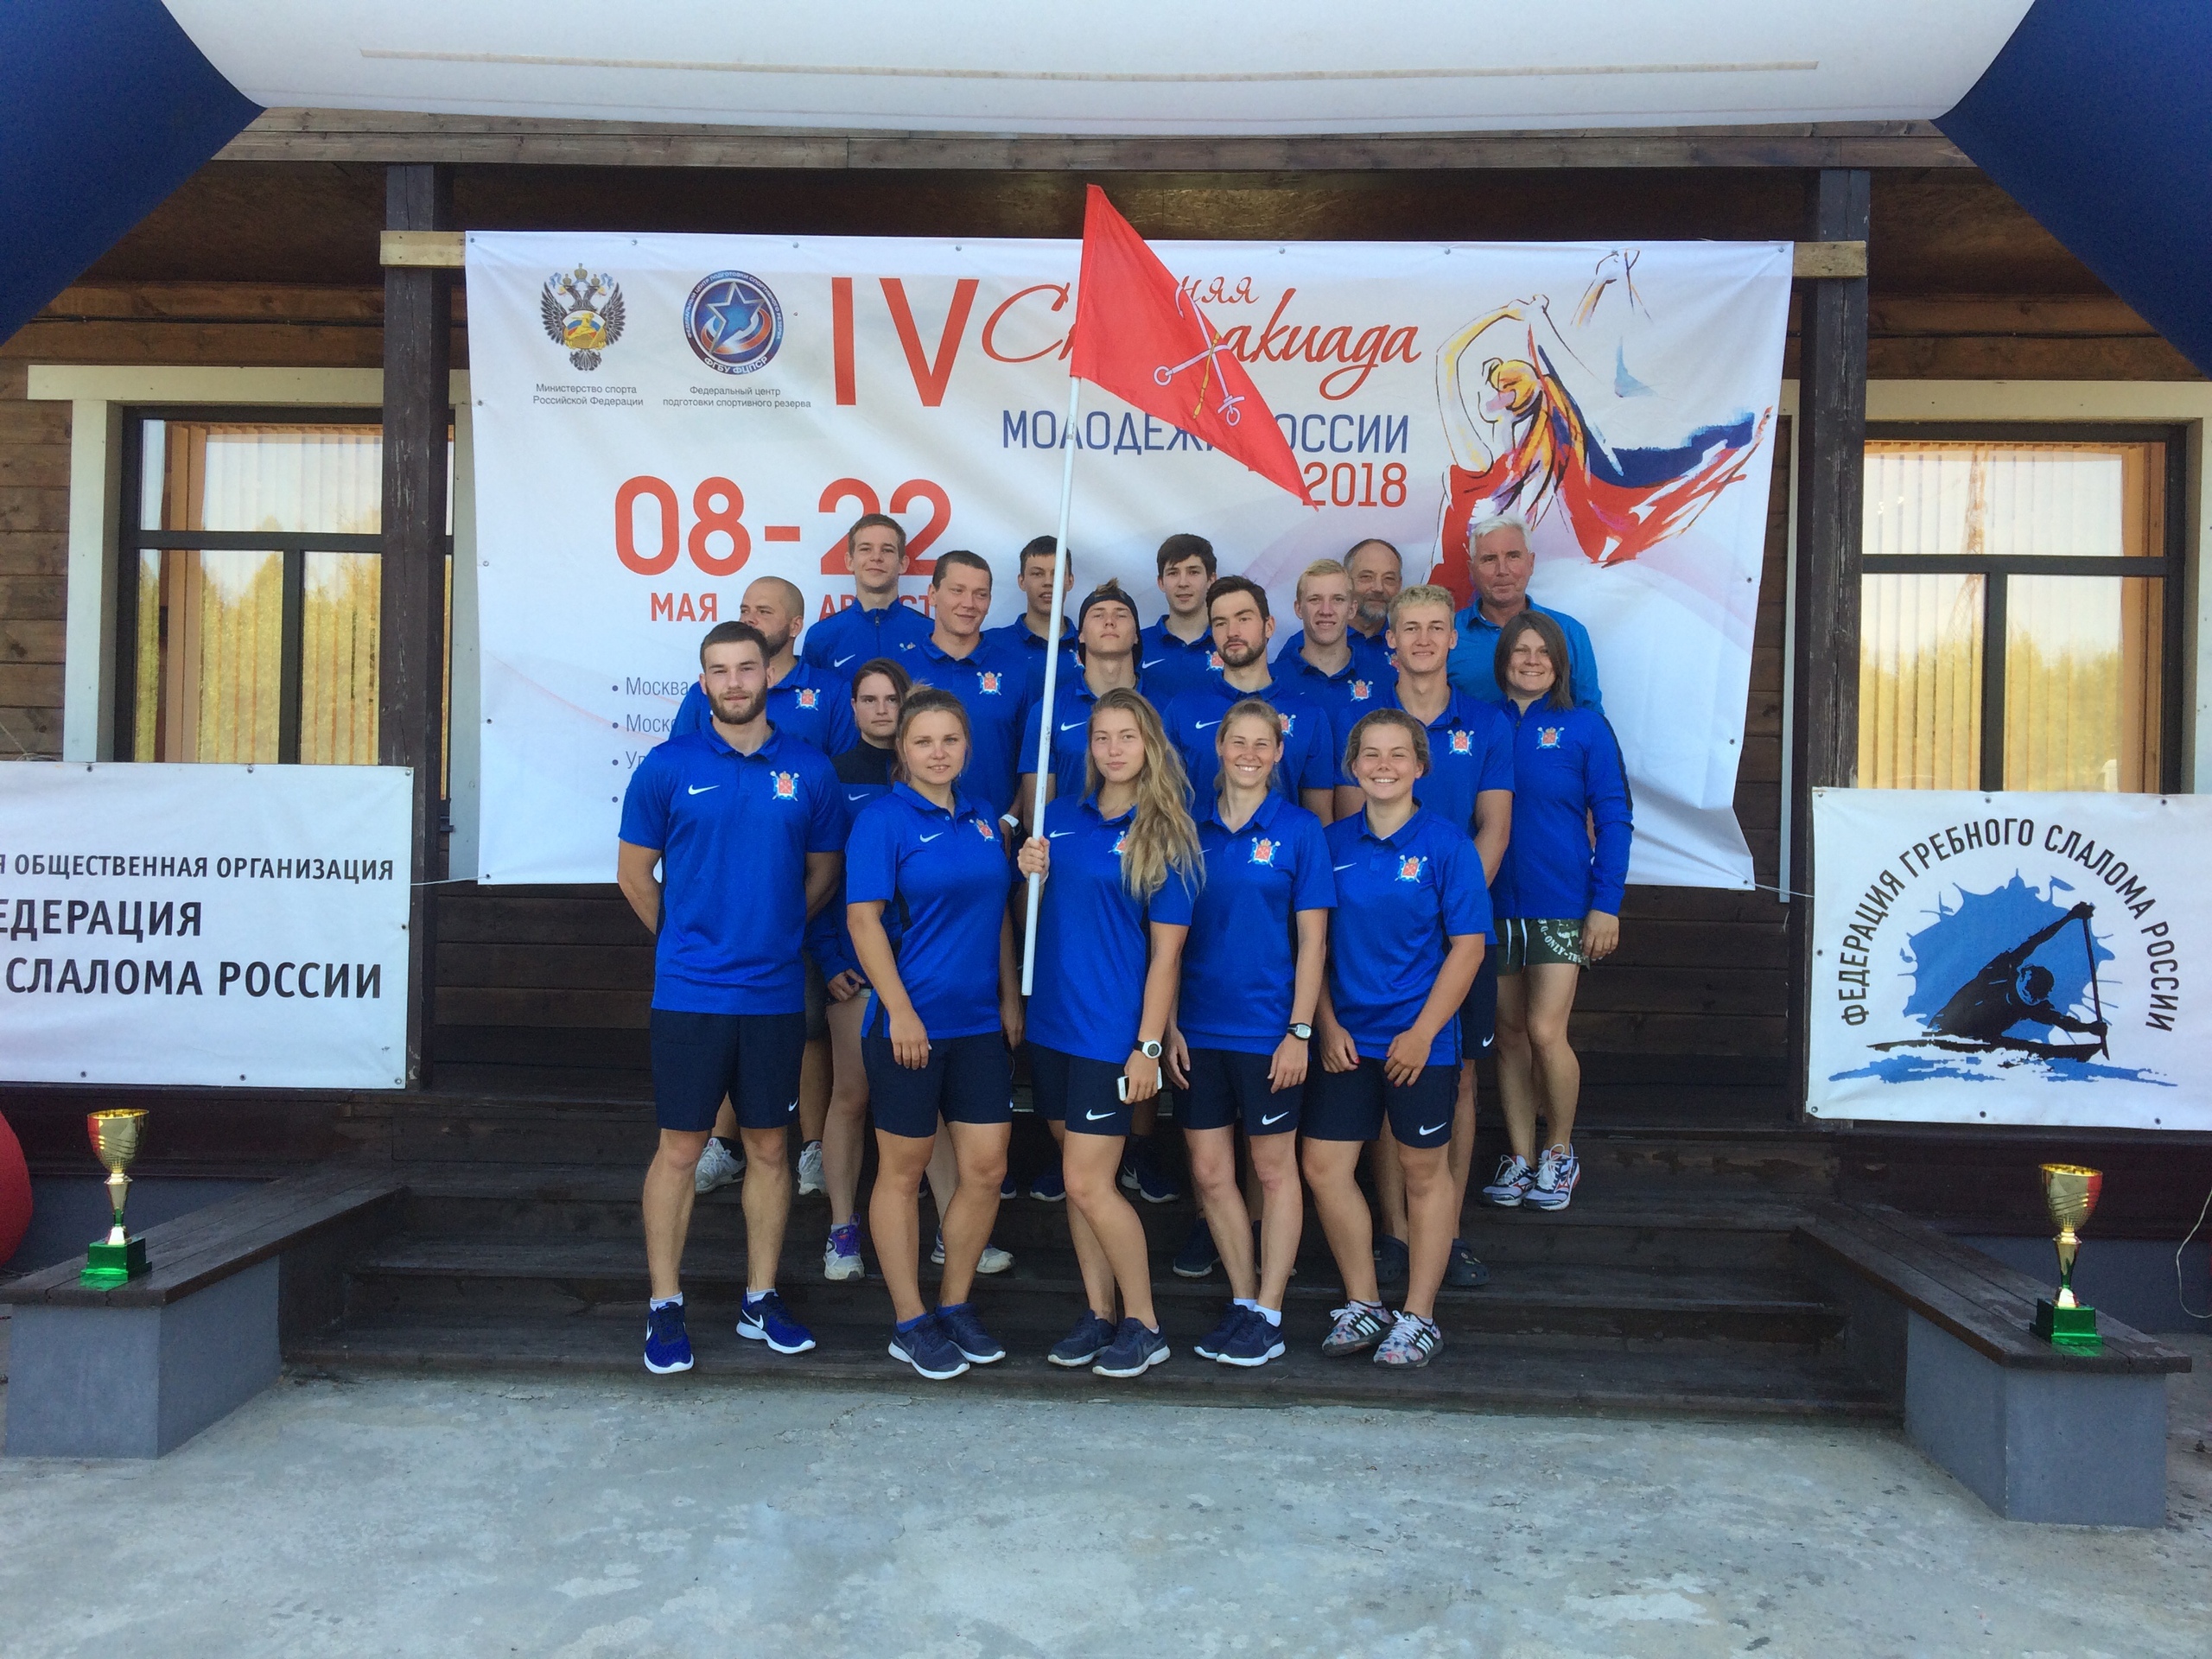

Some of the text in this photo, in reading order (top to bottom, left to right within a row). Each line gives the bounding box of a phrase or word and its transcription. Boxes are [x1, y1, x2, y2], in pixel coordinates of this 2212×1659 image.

[695, 278, 709, 296] ЦЕНТР
[831, 276, 980, 407] IV
[982, 282, 1422, 401] Сакиада
[704, 356, 768, 374] ФГБУ ФЦПСР
[533, 396, 644, 406] Российской Федерации
[536, 384, 638, 395] Министерство спорта
[663, 398, 811, 410] подготовки спортивного резерва
[690, 385, 781, 397] Федеральный центр
[1003, 410, 1408, 455] МОЛОДЕЖ ОССИИ
[1302, 461, 1408, 508] 2018
[651, 593, 718, 622] МАЯ
[626, 677, 689, 696] Москва
[15, 854, 207, 880] ОБЩЕСТВЕННАЯ
[216, 856, 394, 884] ОРГАНИЗАЦИЯ
[1838, 818, 2180, 1033] ФЕДЕРАЦИЯ ГРЕБНОГО СЛАЛОМА РОССИИ
[6, 957, 382, 998] СЛАЛОМА РОССИИ
